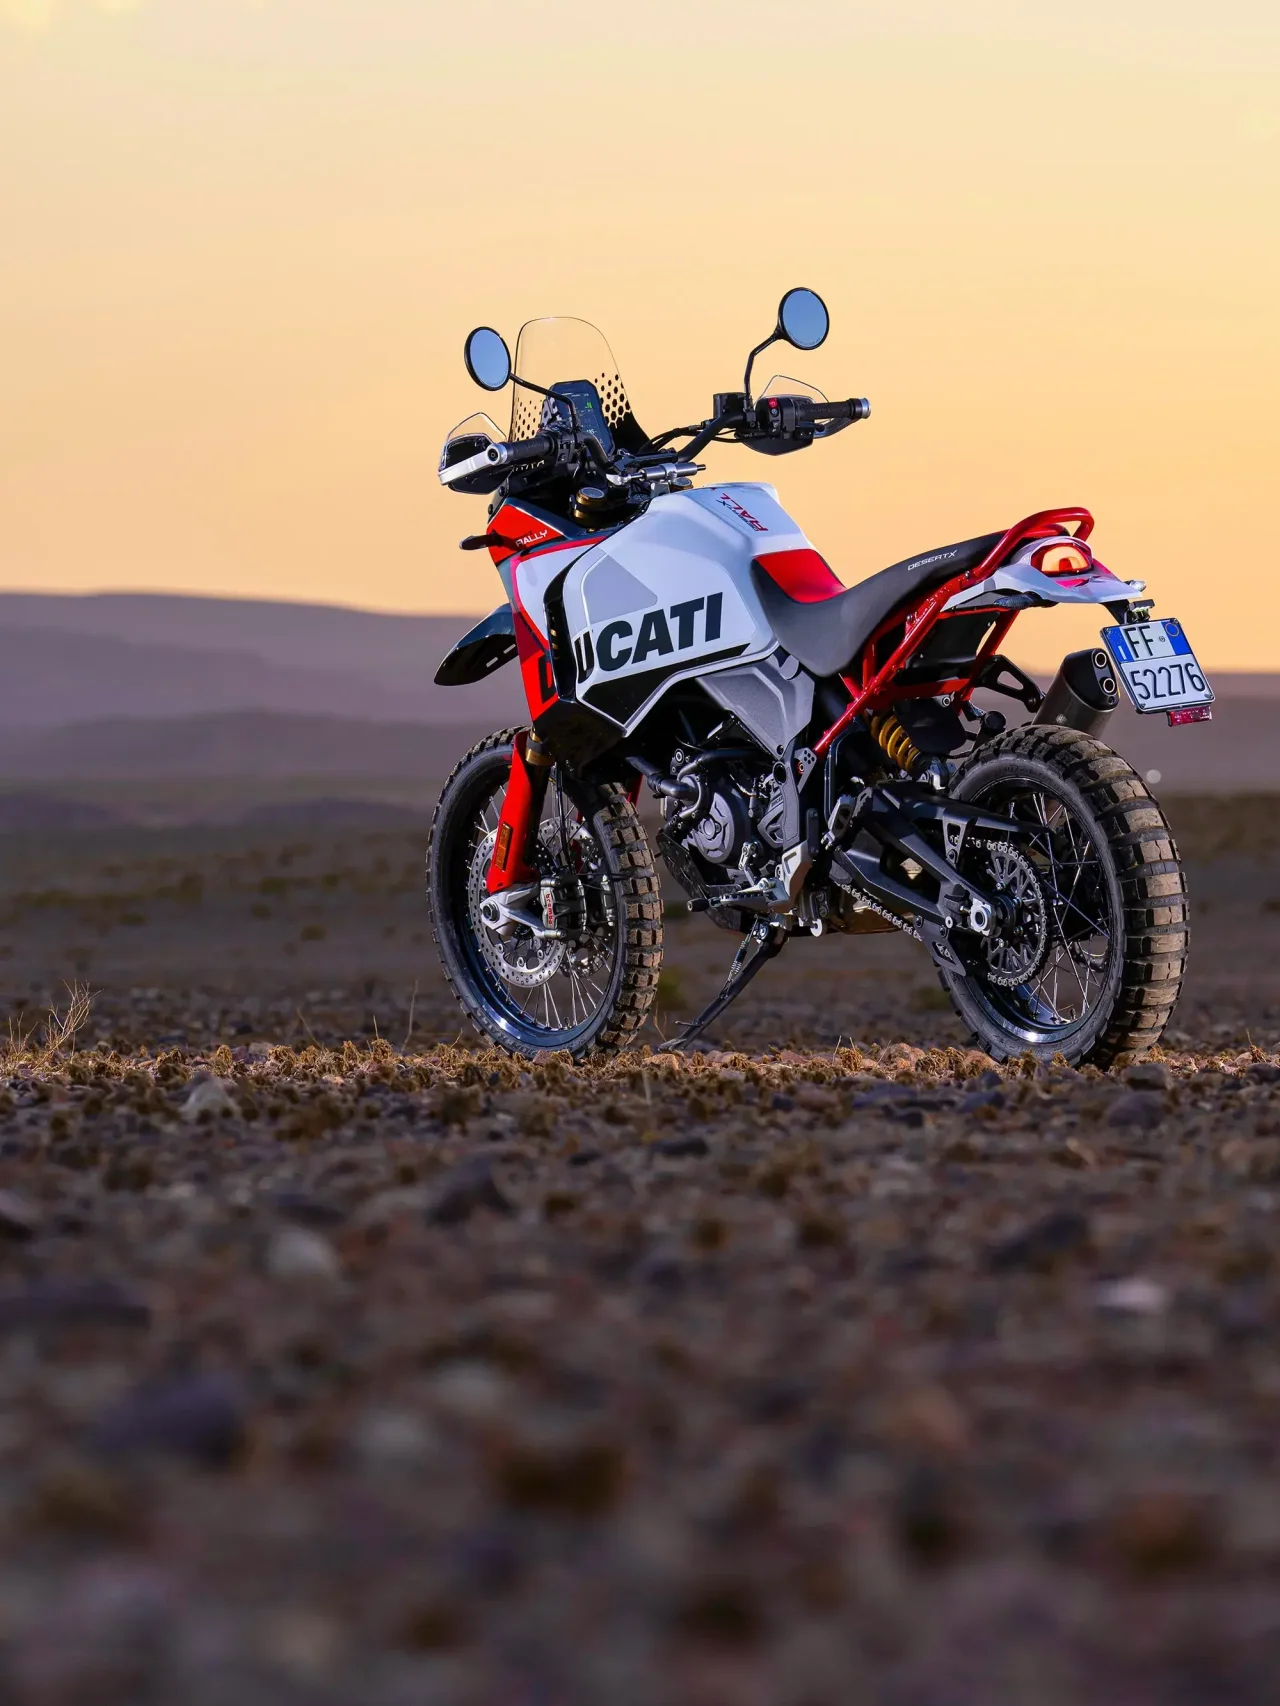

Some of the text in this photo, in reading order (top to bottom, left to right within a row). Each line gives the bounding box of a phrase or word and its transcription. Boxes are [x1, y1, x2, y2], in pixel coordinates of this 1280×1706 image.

[711, 487, 769, 531] RALL
[515, 529, 548, 547] RALLY
[907, 549, 958, 571] DESERTX
[1123, 625, 1154, 658] FF
[1129, 662, 1206, 700] 52276
